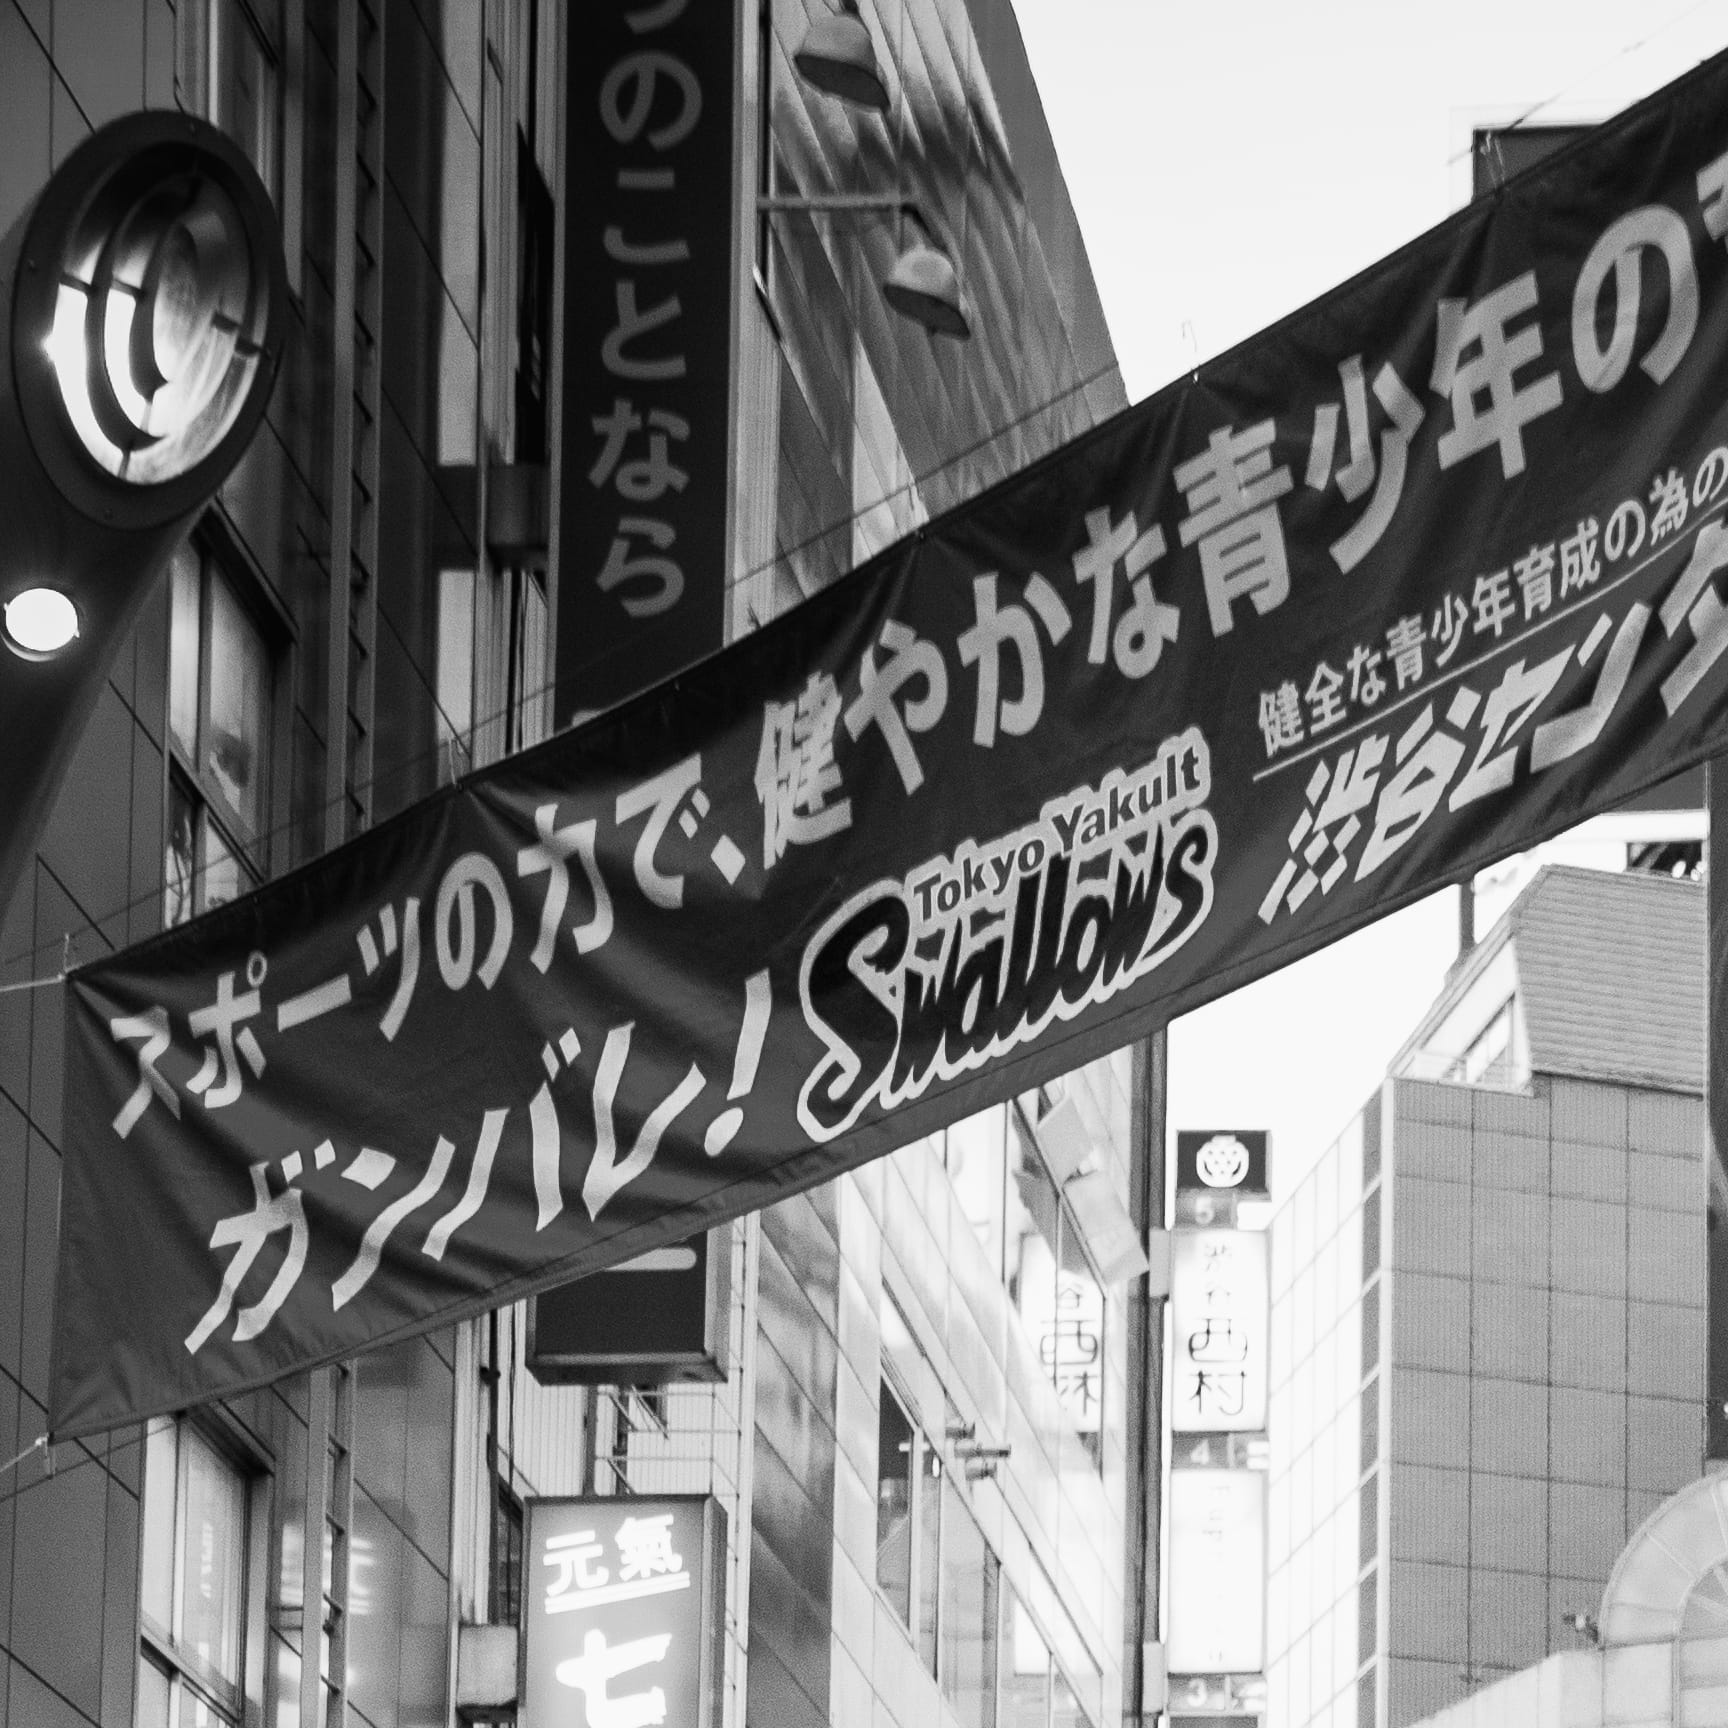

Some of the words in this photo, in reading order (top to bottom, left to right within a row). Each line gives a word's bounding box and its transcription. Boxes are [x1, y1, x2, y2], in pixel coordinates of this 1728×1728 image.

[590, 0, 702, 616] のことなら
[802, 812, 1212, 1140] Swallows
[913, 838, 1045, 924] Tokyo
[1053, 748, 1200, 858] Yakult
